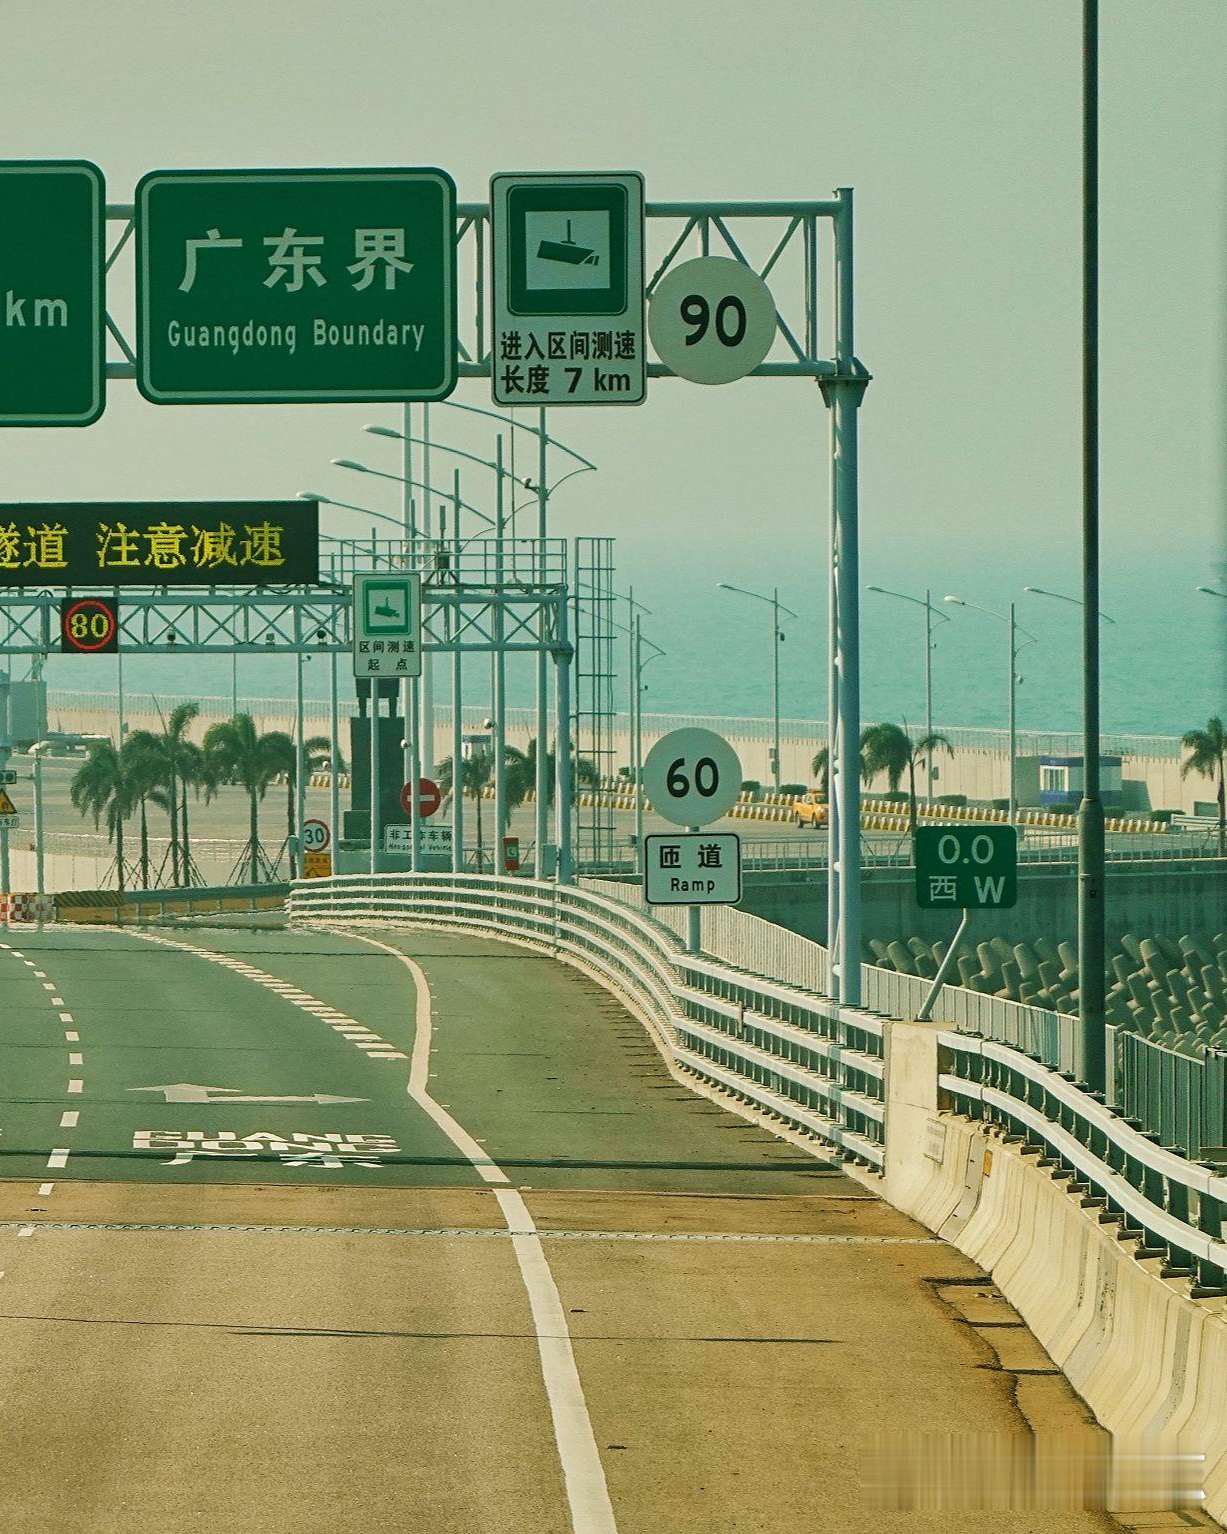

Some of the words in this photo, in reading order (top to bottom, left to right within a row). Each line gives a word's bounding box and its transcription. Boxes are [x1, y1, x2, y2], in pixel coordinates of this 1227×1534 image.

[177, 227, 415, 293] 广东界
[680, 294, 747, 347] 90
[168, 319, 297, 355] Guangdong
[313, 318, 425, 351] Boundary
[500, 330, 636, 361] 进入区间测速
[500, 364, 550, 395] 长度
[564, 367, 583, 394] 7
[594, 367, 631, 392] km
[95, 520, 286, 569] 注意减速
[70, 613, 109, 639] 80
[359, 640, 415, 653] 区间测速
[367, 657, 408, 671] 起点
[666, 756, 720, 799] 60
[303, 828, 324, 844] 30
[938, 834, 995, 865] 0.0
[659, 843, 724, 869] 匝道
[670, 877, 716, 895] Ramp
[929, 875, 958, 902] 西
[973, 875, 1006, 904] W
